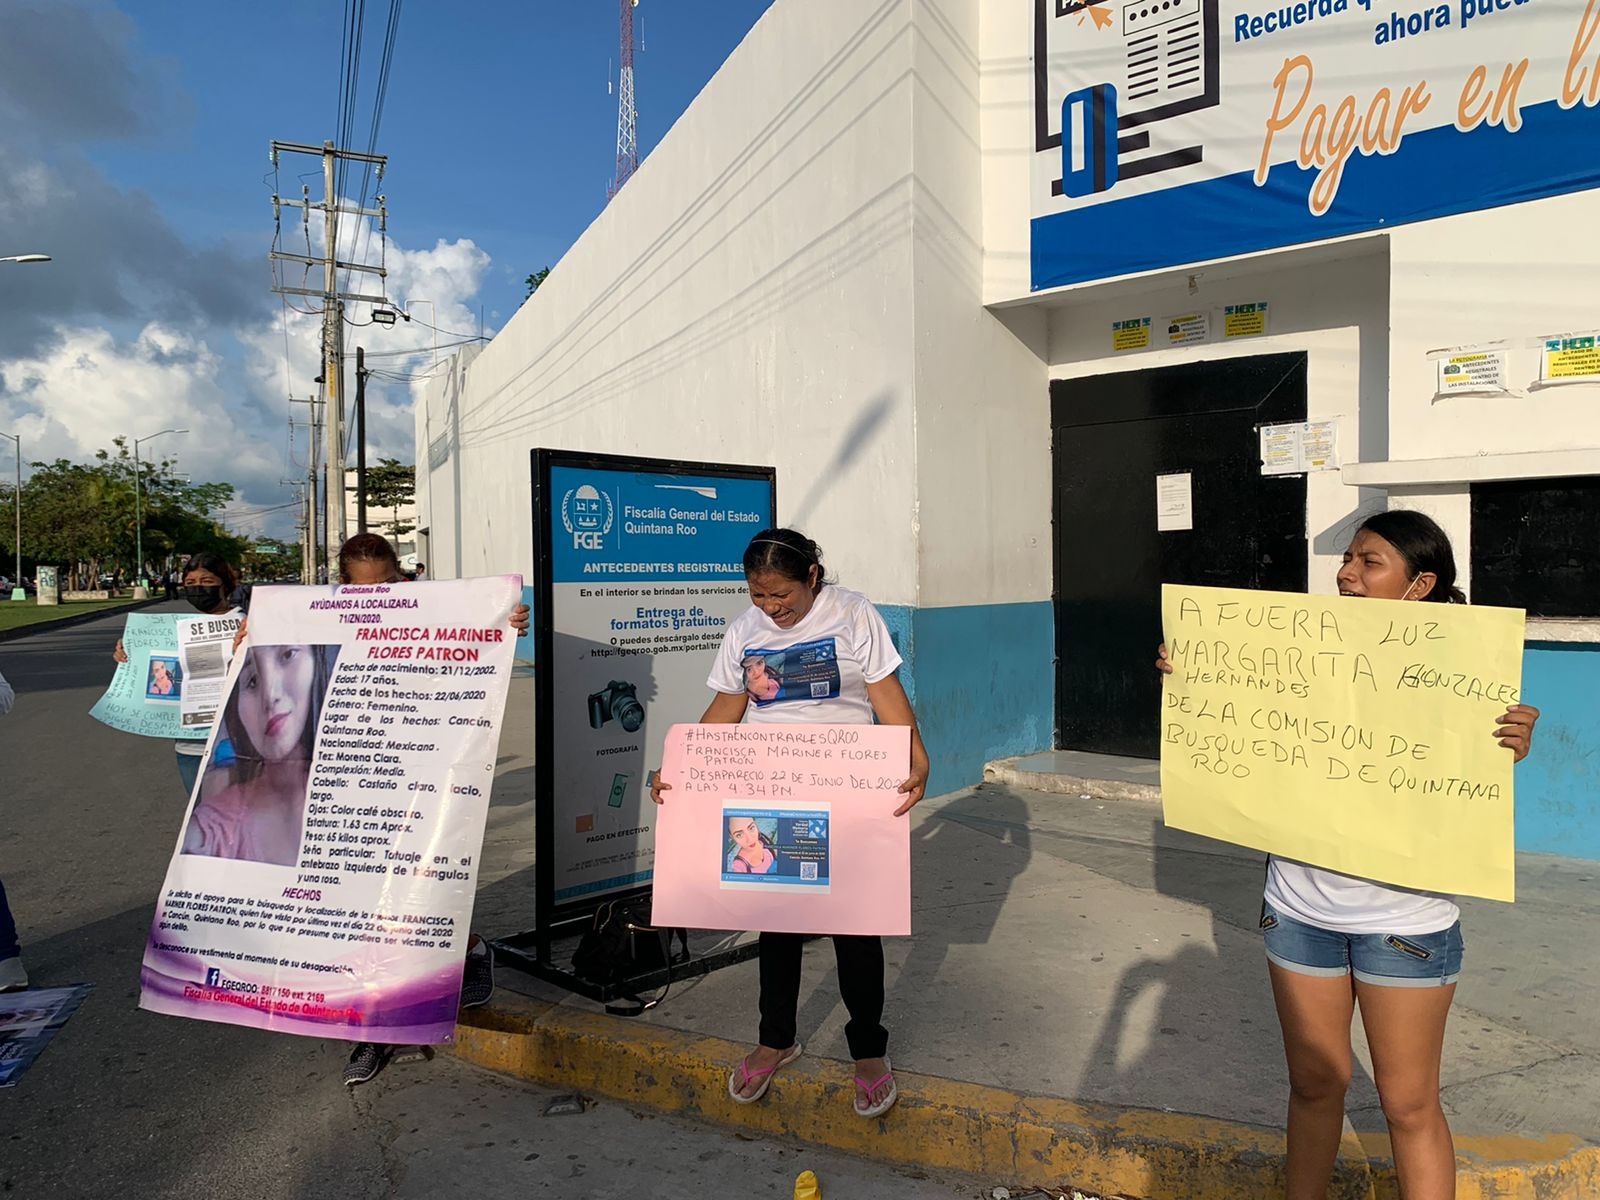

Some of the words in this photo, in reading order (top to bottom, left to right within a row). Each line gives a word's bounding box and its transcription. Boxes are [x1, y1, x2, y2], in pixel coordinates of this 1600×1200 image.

[1234, 0, 1347, 43] Recuerda
[1374, 3, 1451, 45] ahora
[1255, 54, 1433, 213] Pagar
[1457, 57, 1529, 130] en
[668, 508, 708, 521] General
[711, 510, 725, 521] del
[728, 510, 759, 523] Estado
[624, 522, 673, 535] Quintana
[676, 523, 697, 535] Roo
[574, 531, 603, 550] FGE
[583, 563, 674, 574] ANTECEDENTES
[677, 563, 745, 573] REGISTRALES
[341, 586, 373, 594] Quintana
[375, 586, 391, 594] Roo
[580, 588, 592, 597] En
[596, 588, 604, 597] el
[606, 587, 639, 597] interior
[654, 586, 685, 596] brindan
[687, 586, 699, 595] los
[701, 586, 737, 595] servicios
[738, 585, 750, 594] de:
[353, 600, 360, 609] A
[361, 599, 418, 609] LOCALIZARLA
[636, 607, 685, 622] Entrega
[689, 606, 704, 617] de
[1180, 597, 1203, 627] A
[1217, 602, 1344, 642] FUERA
[1378, 620, 1447, 646] LUZ
[190, 622, 204, 637] SE
[610, 618, 669, 630] formatos
[672, 616, 726, 631] gratuitos
[356, 628, 429, 641] FRANCISCA
[434, 628, 503, 642] MARINER
[611, 637, 617, 645] O
[620, 635, 651, 647] puedes
[701, 632, 724, 642] desde
[367, 646, 413, 659] FLORES
[416, 647, 479, 662] PATRON
[338, 662, 365, 672] Fecha
[366, 662, 378, 672] de
[380, 663, 439, 675] nacimiento:
[440, 665, 497, 676] 21/12/2002.
[1171, 637, 1378, 692] MARGARITA
[335, 675, 359, 684] Edad:
[360, 674, 371, 683] 17
[372, 675, 399, 686] años.
[1185, 666, 1310, 699] HERNANDES
[331, 687, 357, 696] Fecha
[359, 687, 372, 697] de
[374, 688, 389, 698] los
[391, 690, 433, 701] hechos:
[434, 691, 486, 702] 22/06/2020
[328, 699, 365, 710] Género:
[367, 701, 419, 713] Femenino.
[324, 713, 349, 724] Lugar
[357, 714, 371, 723] de
[380, 715, 394, 725] los
[402, 716, 441, 726] hechos:
[448, 716, 494, 729] Cancún,
[1167, 692, 1192, 713] DE
[1196, 699, 1238, 727] LA
[1250, 708, 1373, 752] COMISION
[1386, 734, 1431, 760] DE
[322, 725, 364, 736] Quintana
[366, 727, 386, 737] Roo.
[320, 738, 384, 750] Nacionalidad:
[318, 751, 334, 761] Tez:
[336, 752, 371, 763] Morena
[373, 753, 402, 764] Clara.
[687, 744, 757, 757] FRANCISCA
[767, 746, 832, 759] MARINER
[841, 750, 888, 760] FLORES
[704, 756, 754, 766] PATRON
[1165, 723, 1309, 769] BUSQUEDA
[1326, 756, 1380, 784] DE
[1388, 765, 1502, 801] QUINTANA
[1190, 752, 1251, 778] ROO
[315, 764, 372, 776] Complexión:
[373, 766, 406, 777] Media.
[312, 777, 350, 788] Cabello:
[358, 778, 398, 790] Castaño
[690, 767, 764, 782] DESAPARECIO
[770, 771, 786, 781] 22
[791, 772, 804, 784] DE
[809, 774, 844, 787] JUNIO
[850, 774, 873, 789] DEL
[875, 777, 906, 790] 202
[685, 782, 693, 791] A
[696, 783, 719, 792] LAS
[310, 791, 334, 803] largo.
[308, 804, 329, 816] Ojos:
[331, 804, 355, 815] Color
[356, 805, 378, 817] café
[306, 817, 341, 829] Estatura:
[343, 819, 361, 830] 1.63
[362, 821, 379, 831] cm
[305, 831, 325, 842] Peso:
[326, 832, 337, 842] 65
[337, 832, 359, 844] kilos
[360, 835, 391, 847] aprox.
[586, 833, 605, 844] PAGO
[606, 831, 616, 840] EN
[617, 826, 650, 838] EFECTIVO
[302, 844, 322, 856] Seña
[328, 848, 376, 859] particular:
[384, 849, 422, 864] Tatuaje
[433, 856, 448, 865] en
[460, 856, 472, 866] el
[300, 858, 340, 871] antebrazo
[343, 861, 387, 875] izquierdo
[393, 866, 407, 876] de
[297, 874, 303, 884] y
[303, 874, 320, 883] una
[321, 876, 341, 885] rosa.
[281, 886, 321, 901] HECHOS
[221, 979, 260, 995] FGEQROO:
[213, 992, 246, 1005] General
